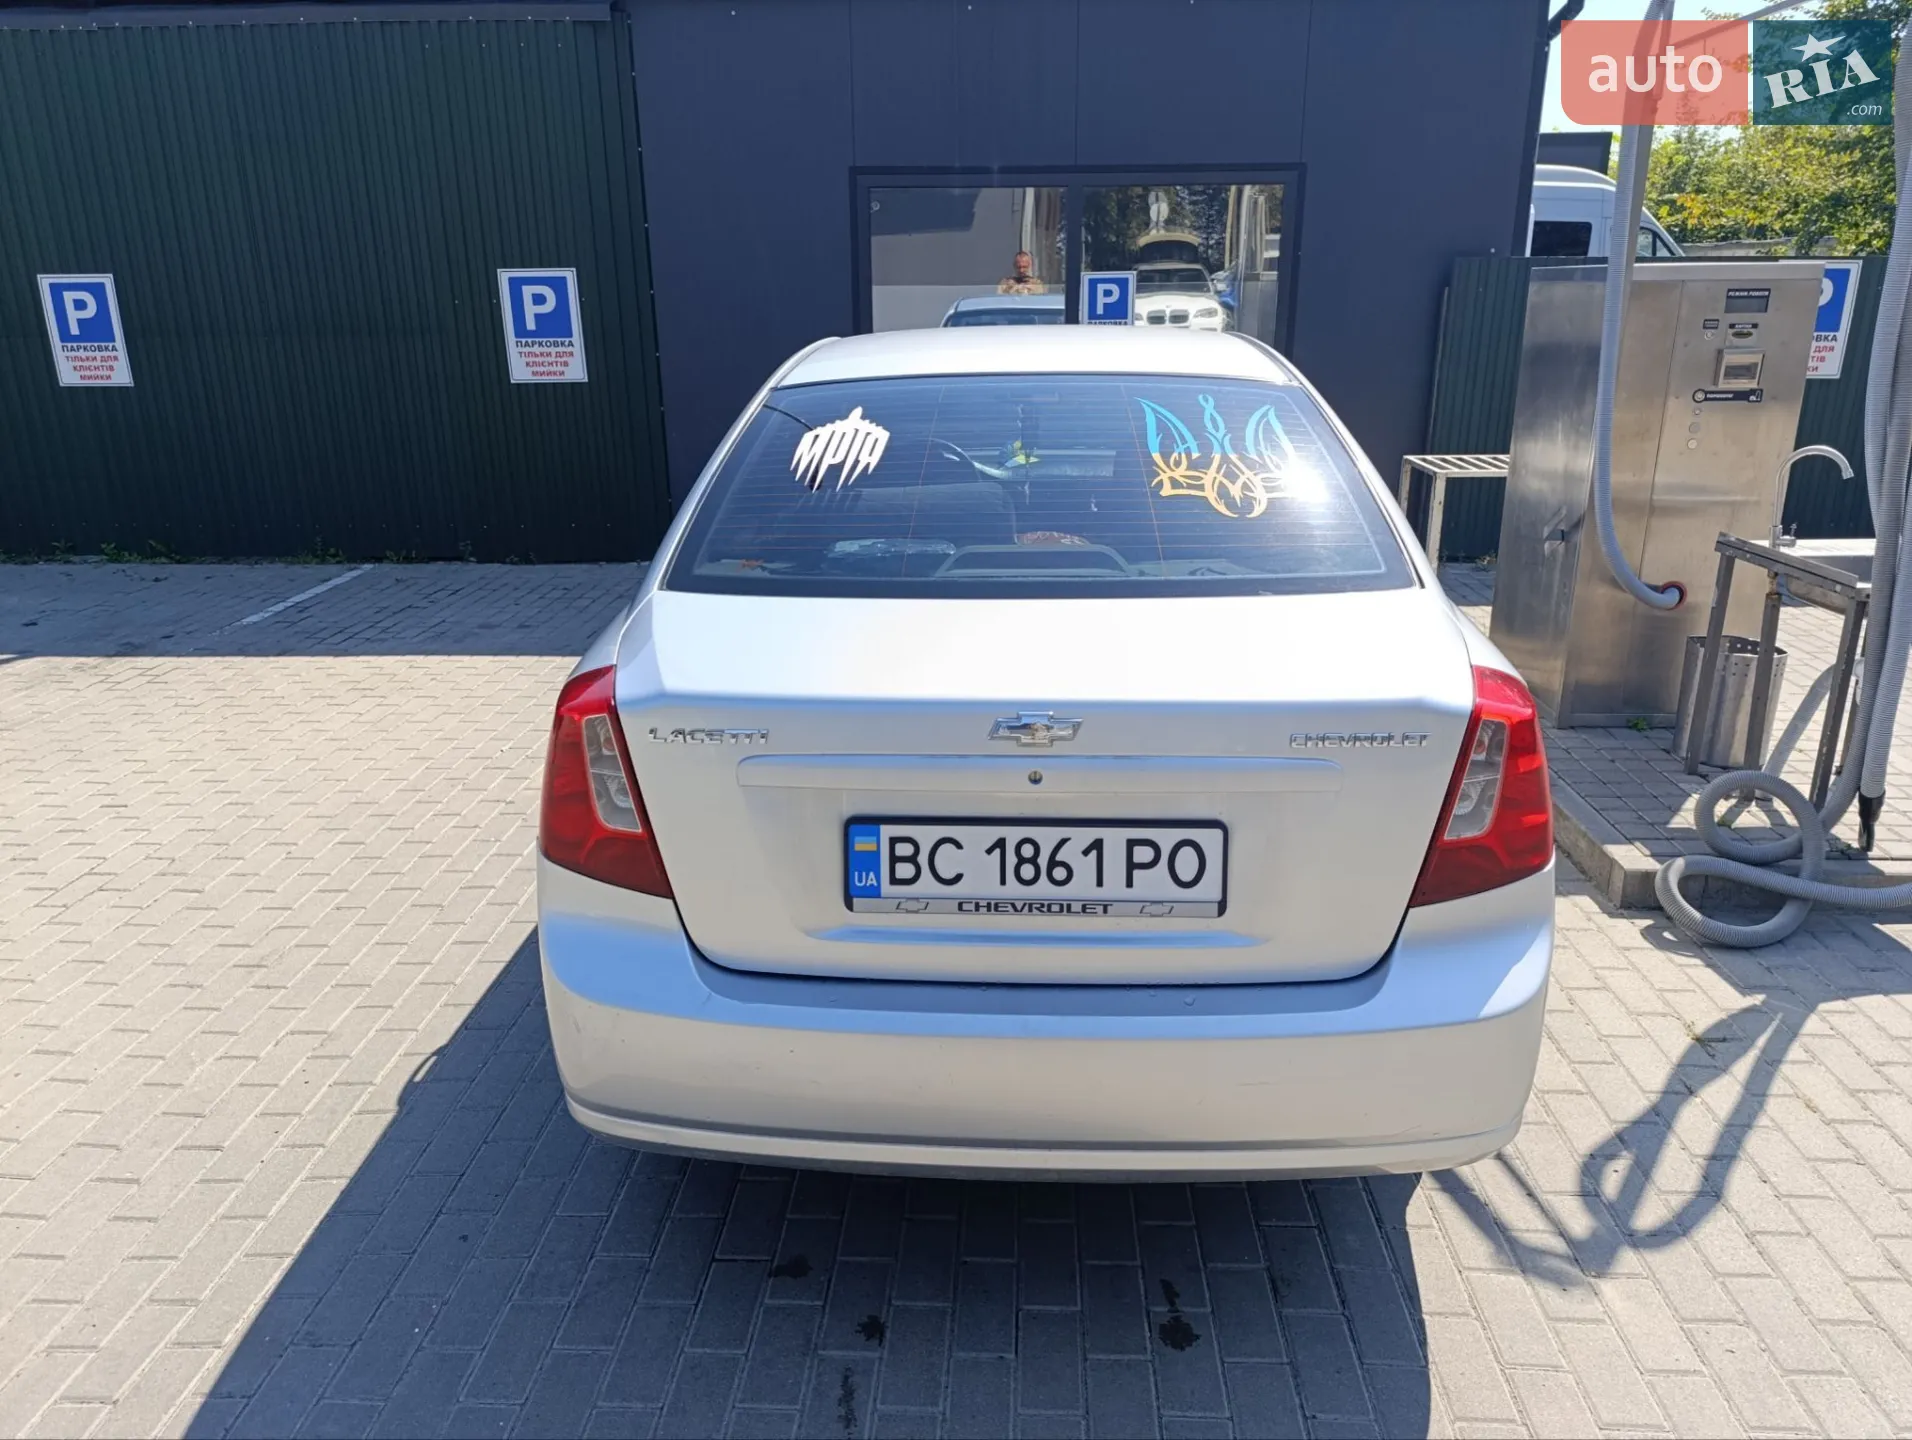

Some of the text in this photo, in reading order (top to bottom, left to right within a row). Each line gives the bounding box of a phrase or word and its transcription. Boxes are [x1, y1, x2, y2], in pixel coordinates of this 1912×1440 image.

[1096, 283, 1120, 315] P
[62, 291, 98, 336] P
[521, 285, 557, 331] P
[61, 344, 118, 353] ПАРКОВКА
[515, 340, 575, 348] ПАРКОВКА
[1813, 345, 1835, 353] ДЛЯ
[100, 355, 119, 363] ДЛЯ
[554, 351, 574, 359] ДЛЯ
[531, 369, 565, 377] МИЙКИ
[648, 727, 769, 744] LACETTI
[1289, 732, 1432, 749] CHEVROLET
[888, 836, 1207, 889] BC 1861 PO
[854, 871, 878, 887] UA
[957, 900, 1114, 915] CHEVROLET
